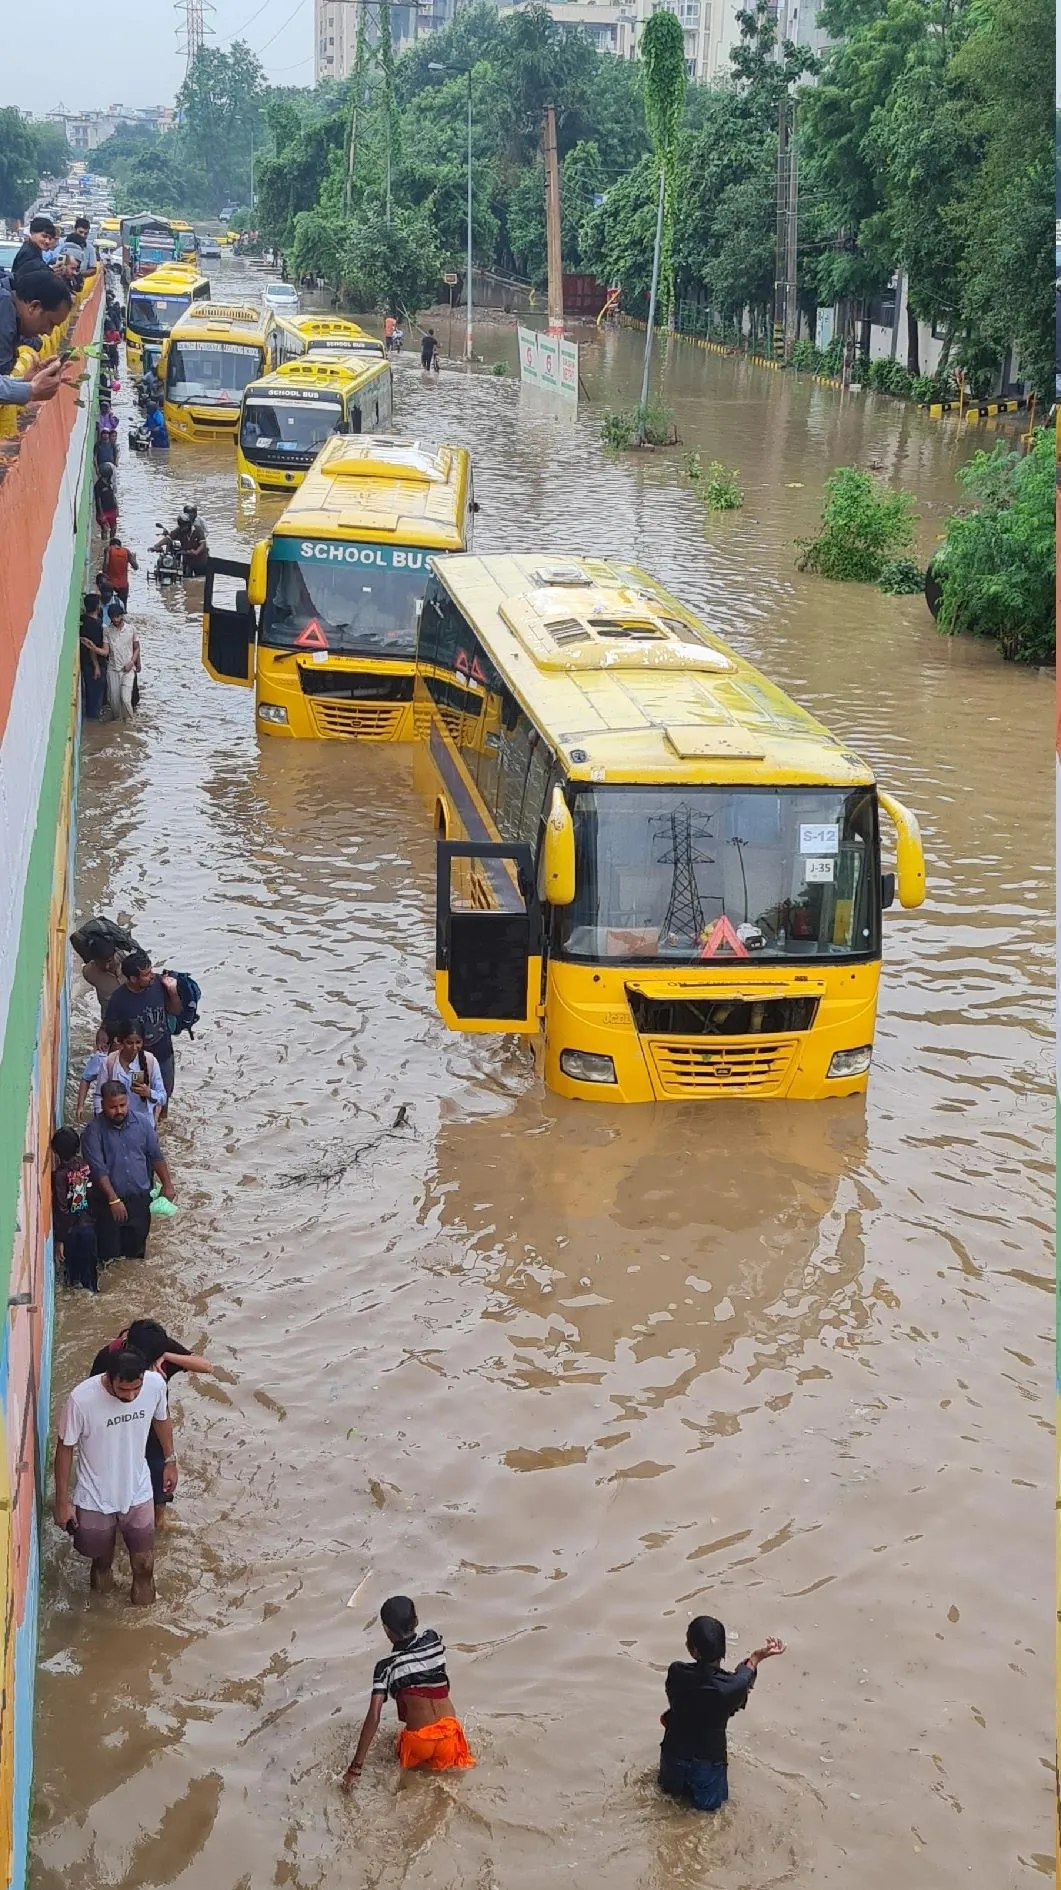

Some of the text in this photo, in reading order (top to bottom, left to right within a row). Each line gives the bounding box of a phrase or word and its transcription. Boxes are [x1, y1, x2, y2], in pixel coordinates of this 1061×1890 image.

[268, 389, 300, 397] SCHOOL
[300, 542, 387, 566] SCHOOL
[804, 831, 835, 841] S-12
[809, 863, 831, 873] J-35
[106, 1410, 145, 1428] ADIDAS
